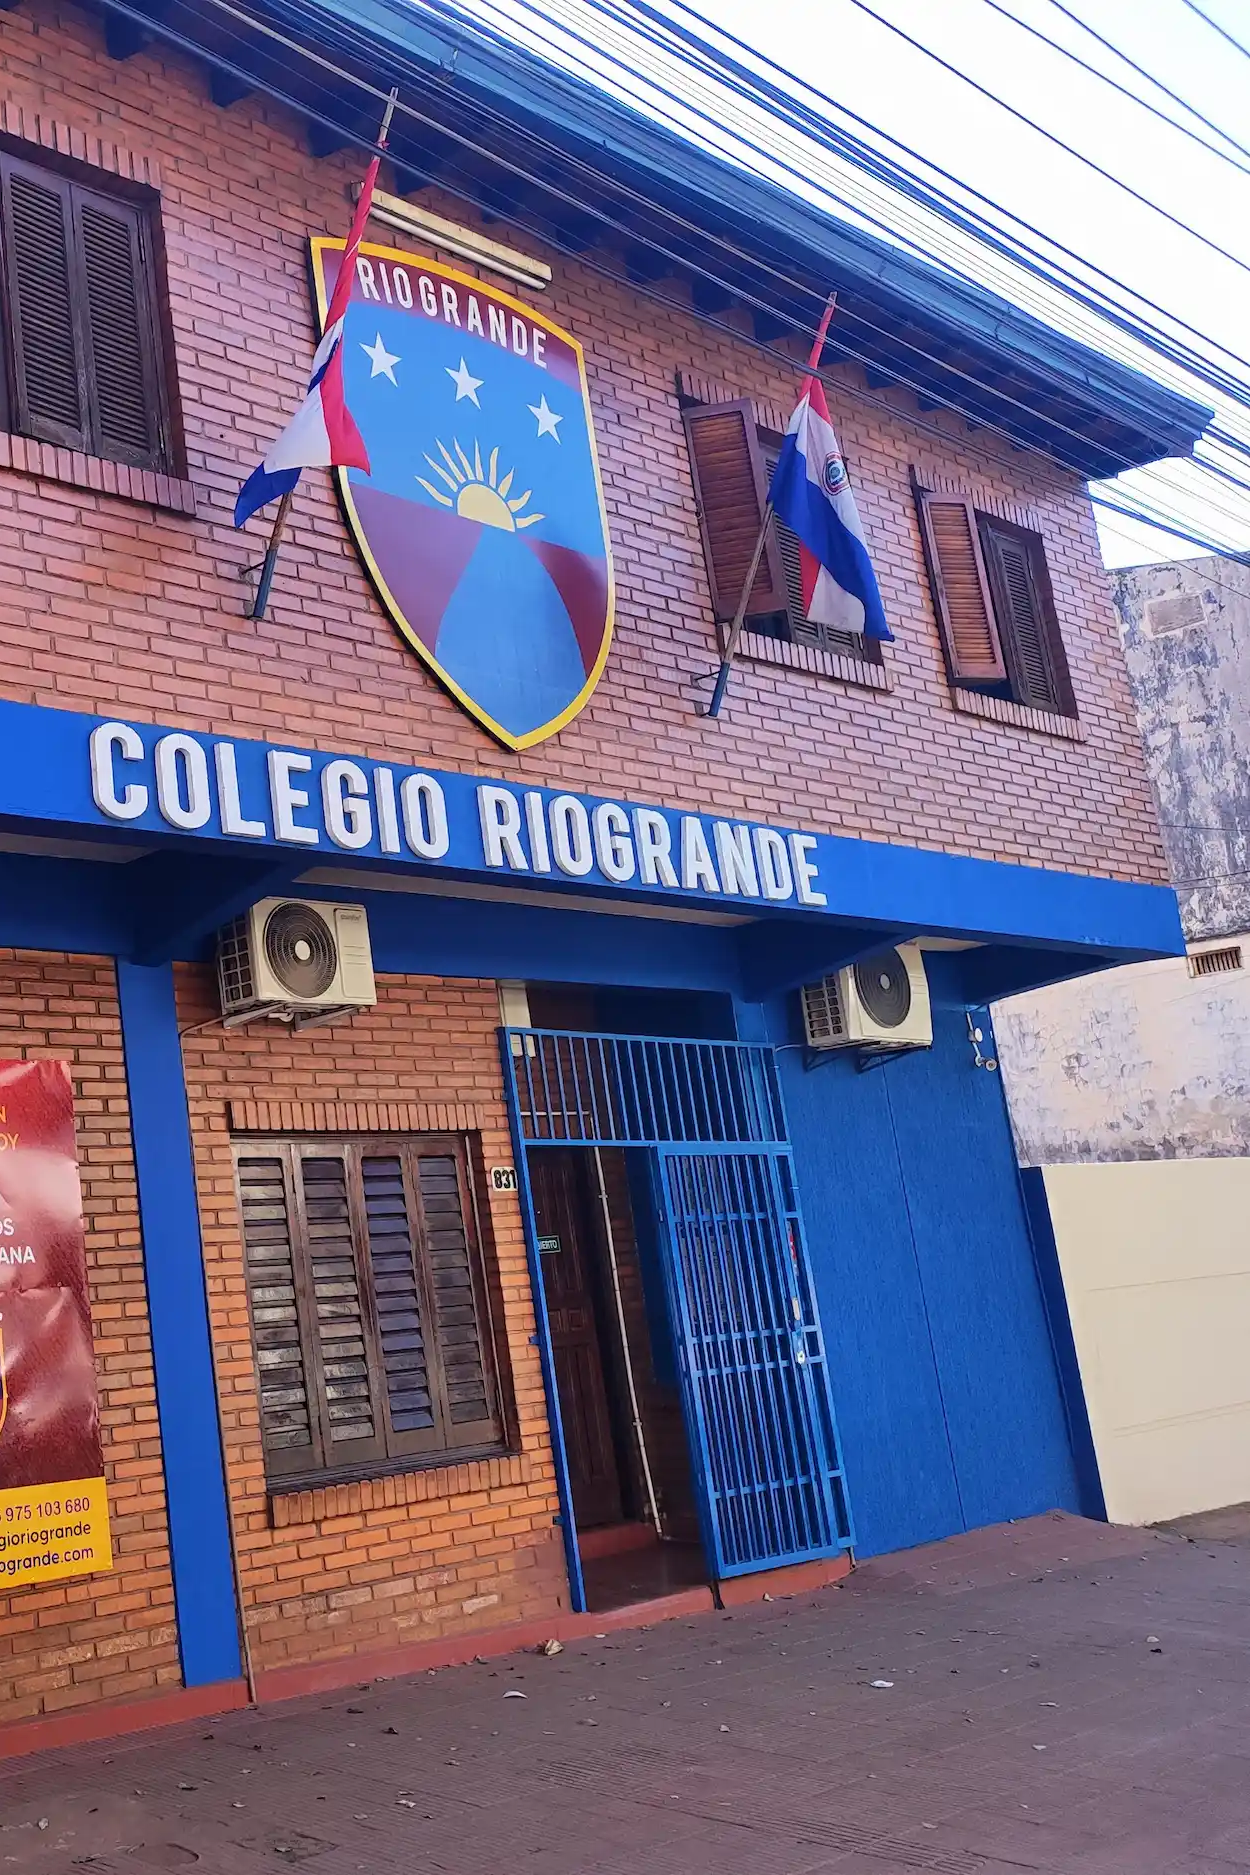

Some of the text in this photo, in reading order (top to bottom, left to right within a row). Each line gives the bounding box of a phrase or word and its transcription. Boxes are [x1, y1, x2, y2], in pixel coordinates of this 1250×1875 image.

[355, 257, 548, 370] RIOGRANDE
[88, 722, 829, 907] COLEGIO RIOGRANDE
[493, 1169, 517, 1188] 831
[5, 1503, 32, 1522] 975
[35, 1499, 61, 1518] 103
[64, 1496, 91, 1515] 680
